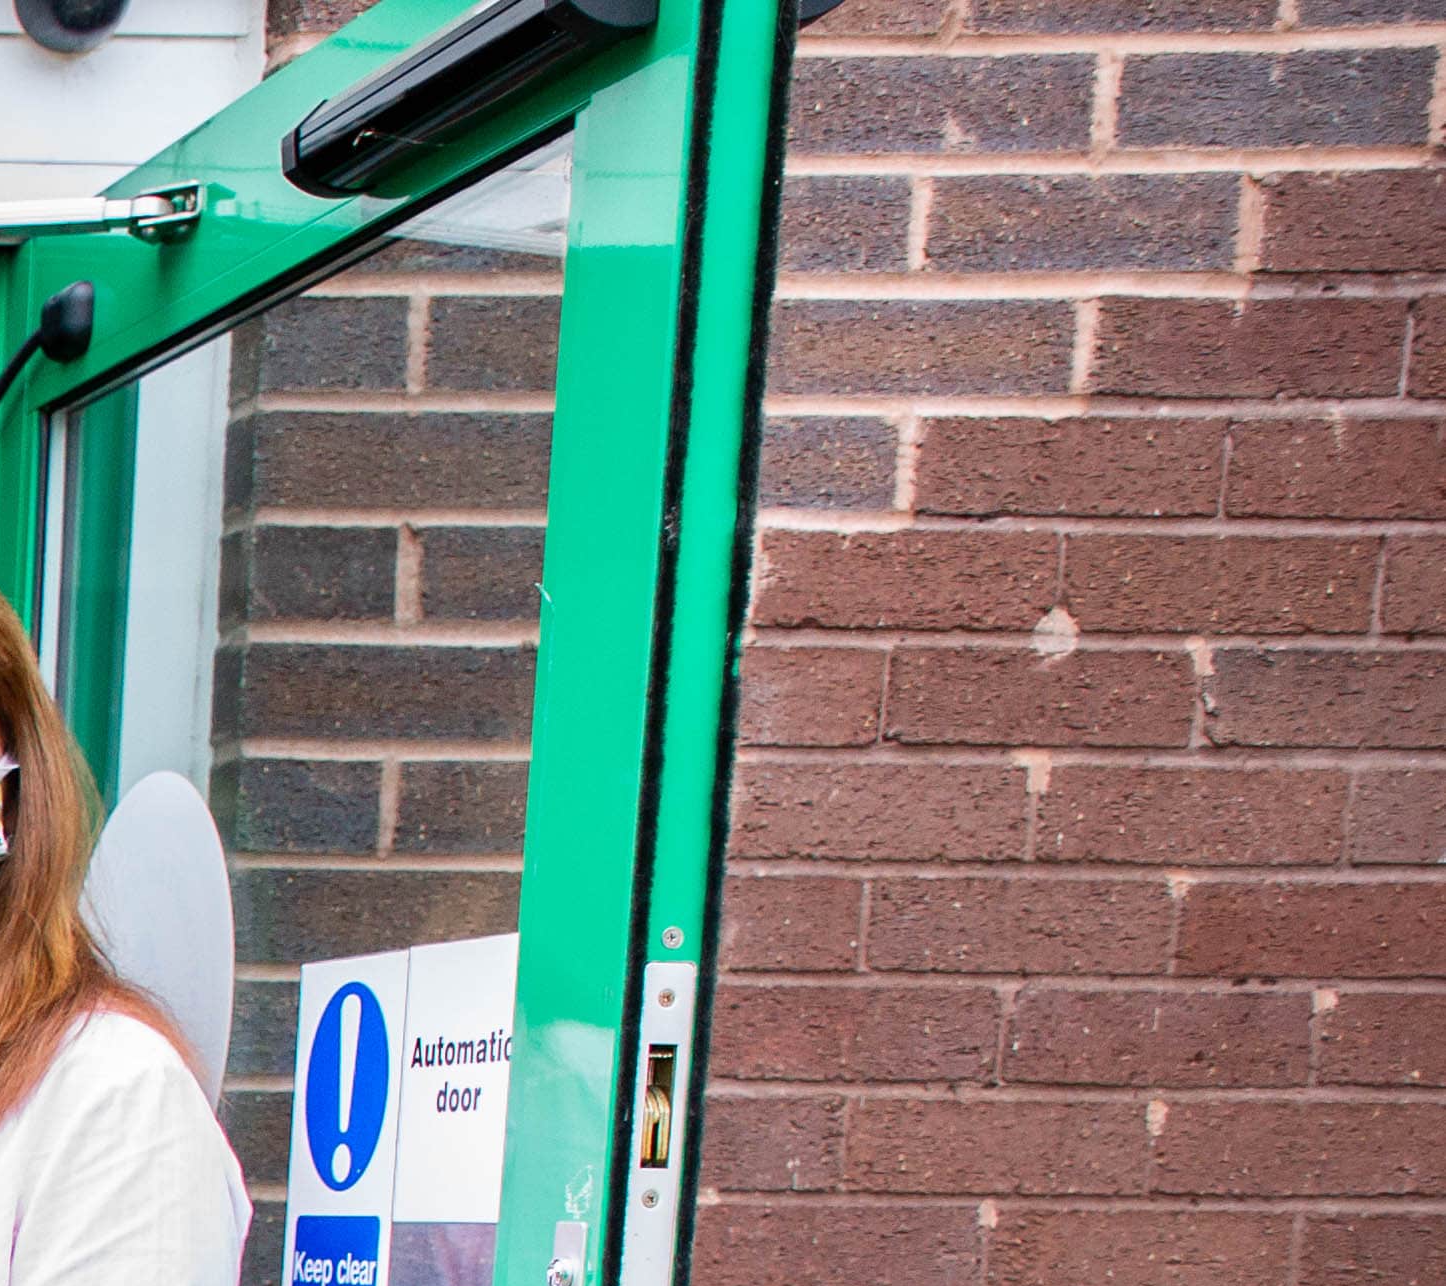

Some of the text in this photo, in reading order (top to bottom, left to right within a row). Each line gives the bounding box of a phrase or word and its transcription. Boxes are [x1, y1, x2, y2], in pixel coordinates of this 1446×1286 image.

[410, 1029, 512, 1069] Automatic
[436, 1081, 481, 1113] door
[336, 1252, 376, 1285] clear
